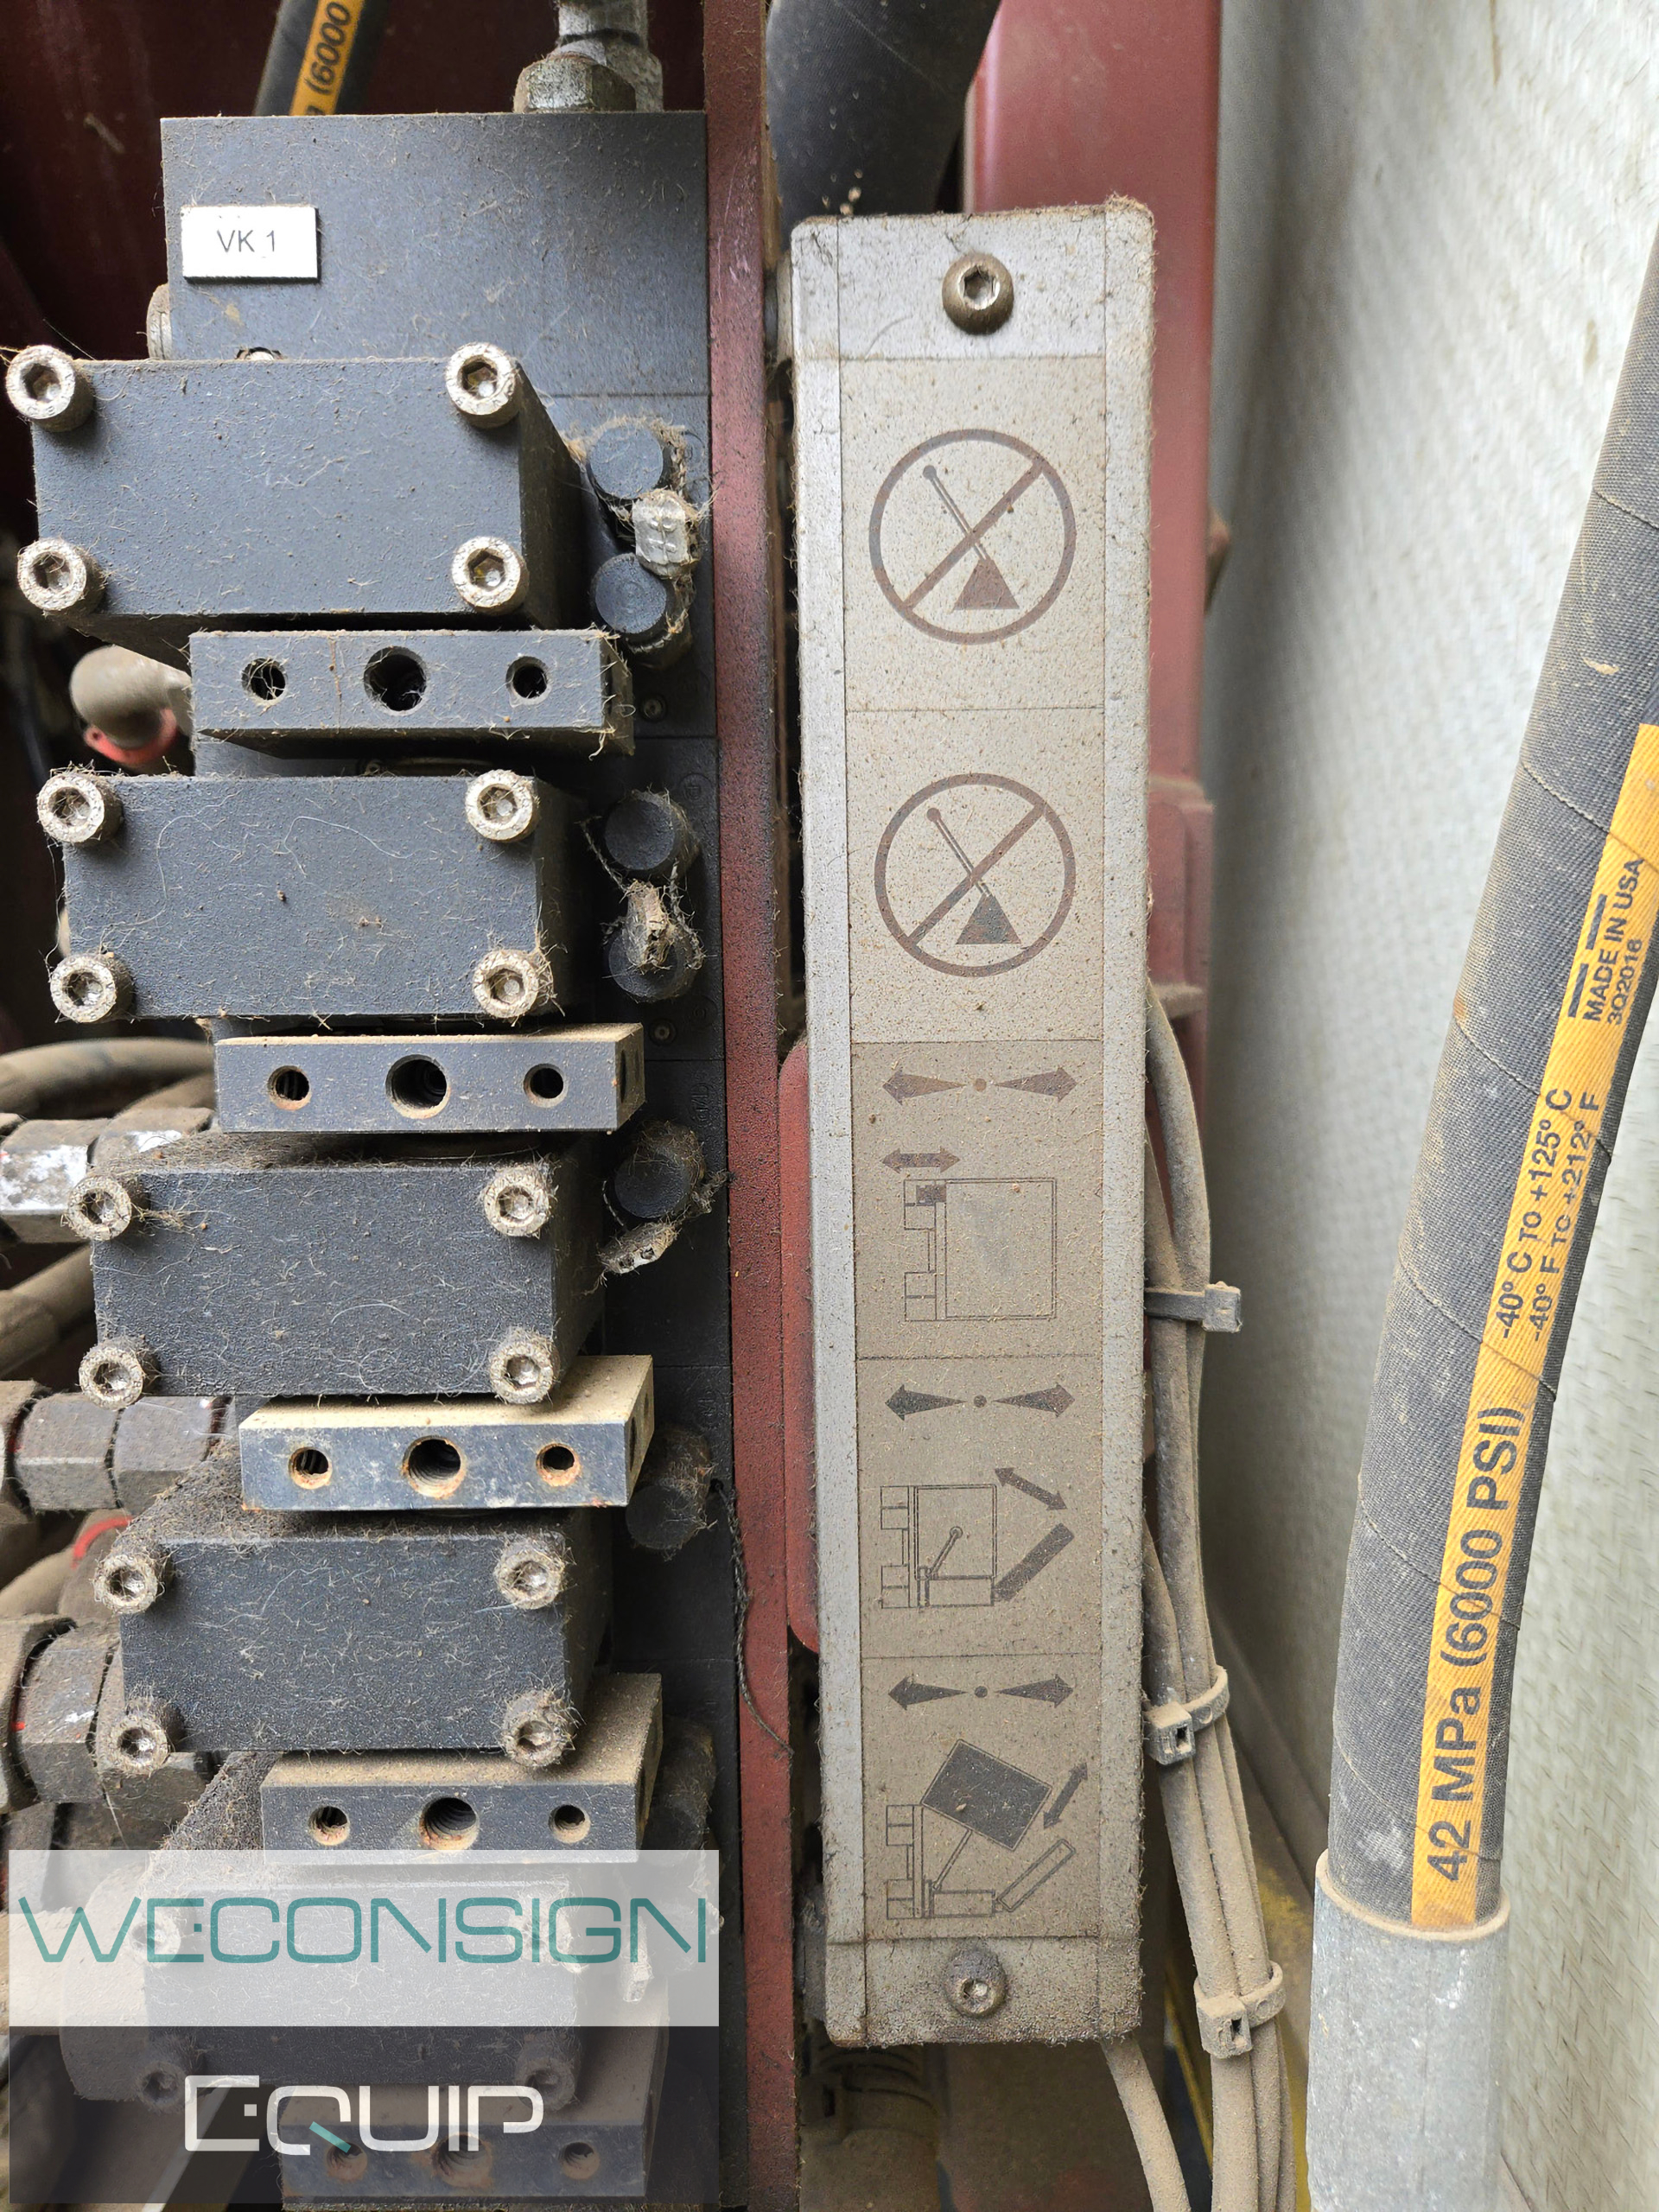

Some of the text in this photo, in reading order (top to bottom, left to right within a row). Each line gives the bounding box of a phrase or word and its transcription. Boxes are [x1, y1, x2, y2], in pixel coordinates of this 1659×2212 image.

[304, 2, 350, 95] (6000
[217, 230, 275, 252] VK 1
[1582, 857, 1644, 1022] MADE IN USA
[1545, 1089, 1572, 1111] C
[1539, 1255, 1560, 1274] F
[1551, 1215, 1571, 1247] TO
[1579, 1091, 1599, 1111] F
[1518, 1211, 1542, 1243] TO
[1506, 1251, 1533, 1274] C
[1427, 1406, 1525, 1882] 42 MPa (6000 PSI)
